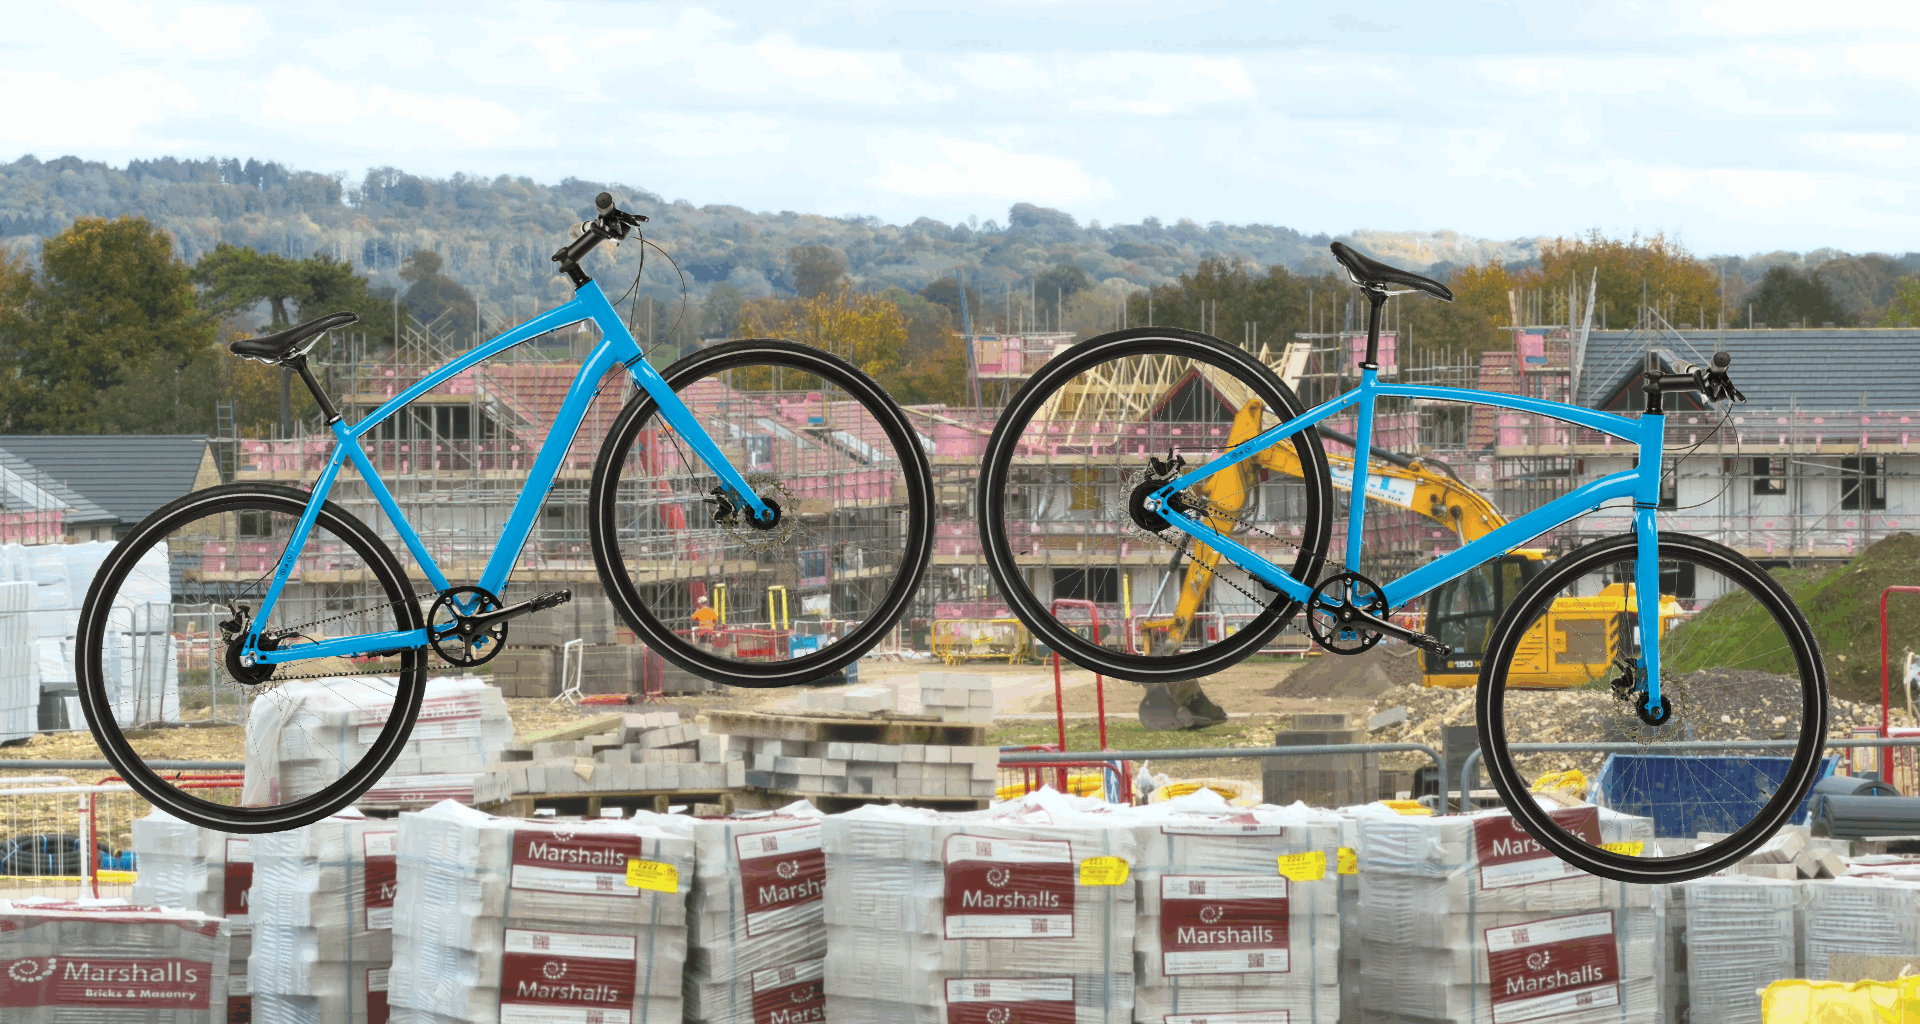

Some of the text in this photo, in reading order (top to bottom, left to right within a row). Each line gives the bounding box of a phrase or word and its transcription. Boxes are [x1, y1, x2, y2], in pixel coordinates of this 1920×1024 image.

[528, 841, 625, 866] Marshalls
[962, 889, 1059, 908] Marshalls
[1177, 925, 1273, 944] Marshalls
[64, 961, 198, 983] Marshalls
[1505, 964, 1603, 995] Marshalls
[85, 989, 196, 1001] Bricks & Masonry
[517, 980, 618, 1003] Marshalls
